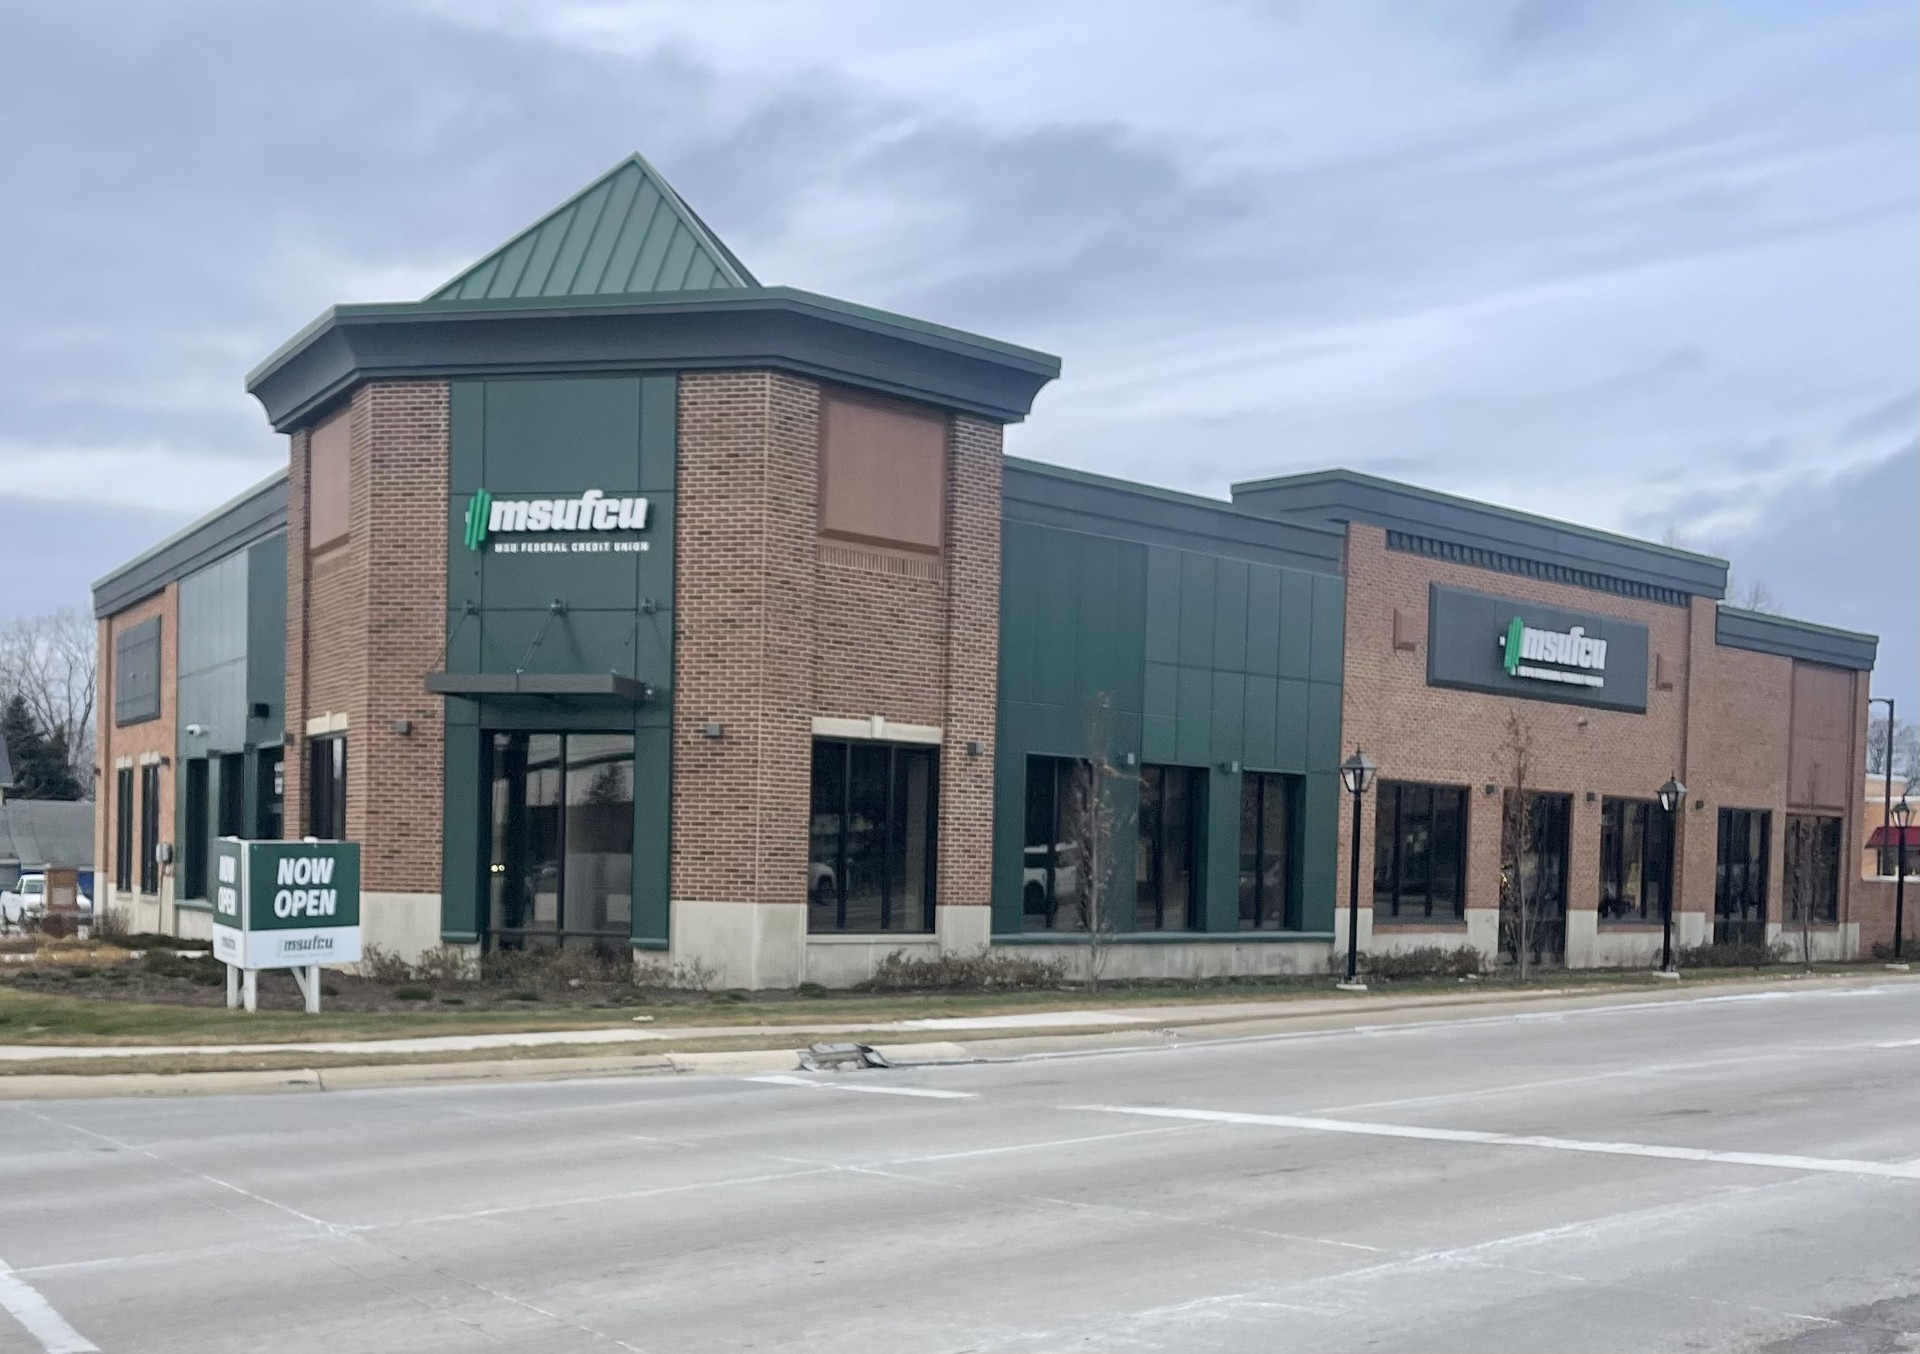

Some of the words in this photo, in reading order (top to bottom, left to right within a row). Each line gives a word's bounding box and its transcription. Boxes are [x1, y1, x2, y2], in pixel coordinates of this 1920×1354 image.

[488, 489, 648, 531] msufcu
[521, 543, 567, 552] FEDERAL
[571, 542, 610, 551] CREDIT
[613, 541, 650, 551] UNION
[277, 857, 335, 885] NOW
[273, 888, 337, 918] OPEN
